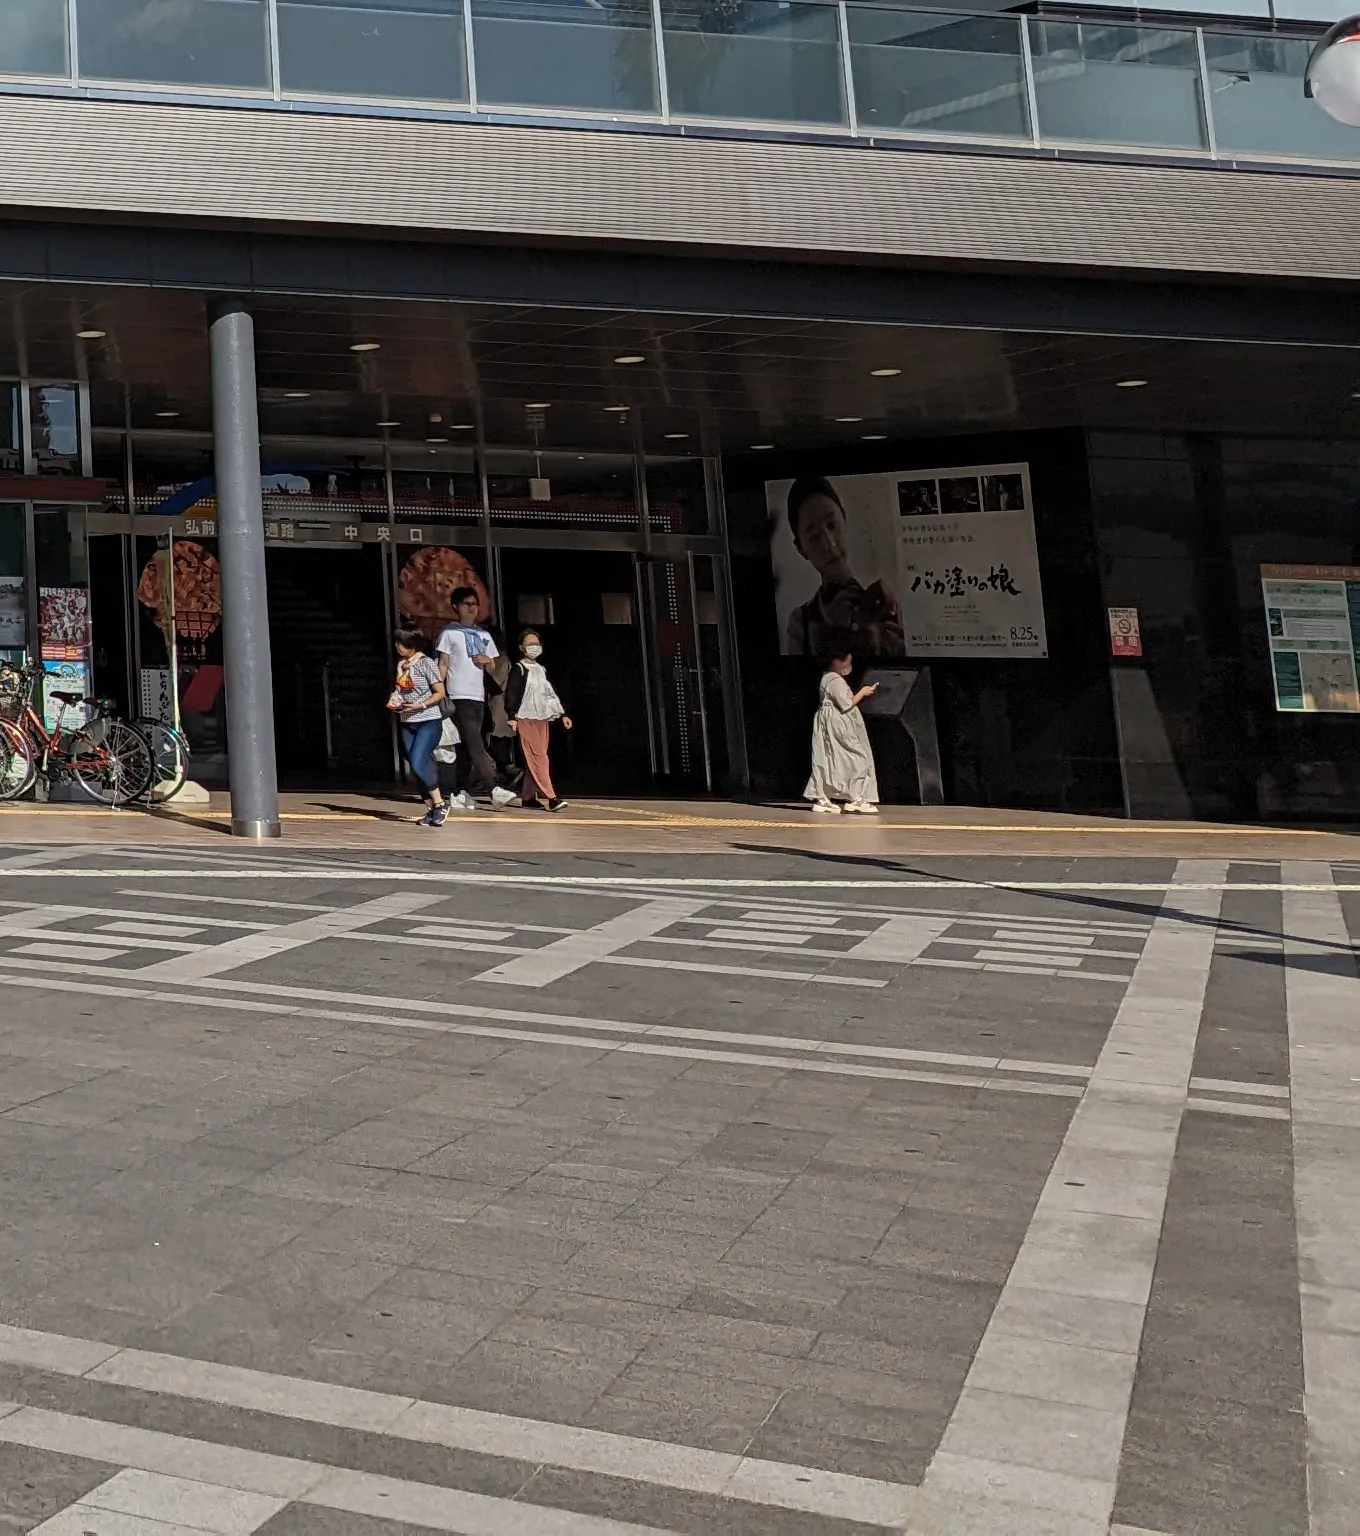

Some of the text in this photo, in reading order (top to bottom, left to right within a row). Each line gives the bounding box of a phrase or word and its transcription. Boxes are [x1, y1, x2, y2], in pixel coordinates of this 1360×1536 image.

[344, 524, 423, 542] 中央口
[910, 563, 1022, 598] バカ塗りの娘
[1009, 626, 1034, 641] 8.25
